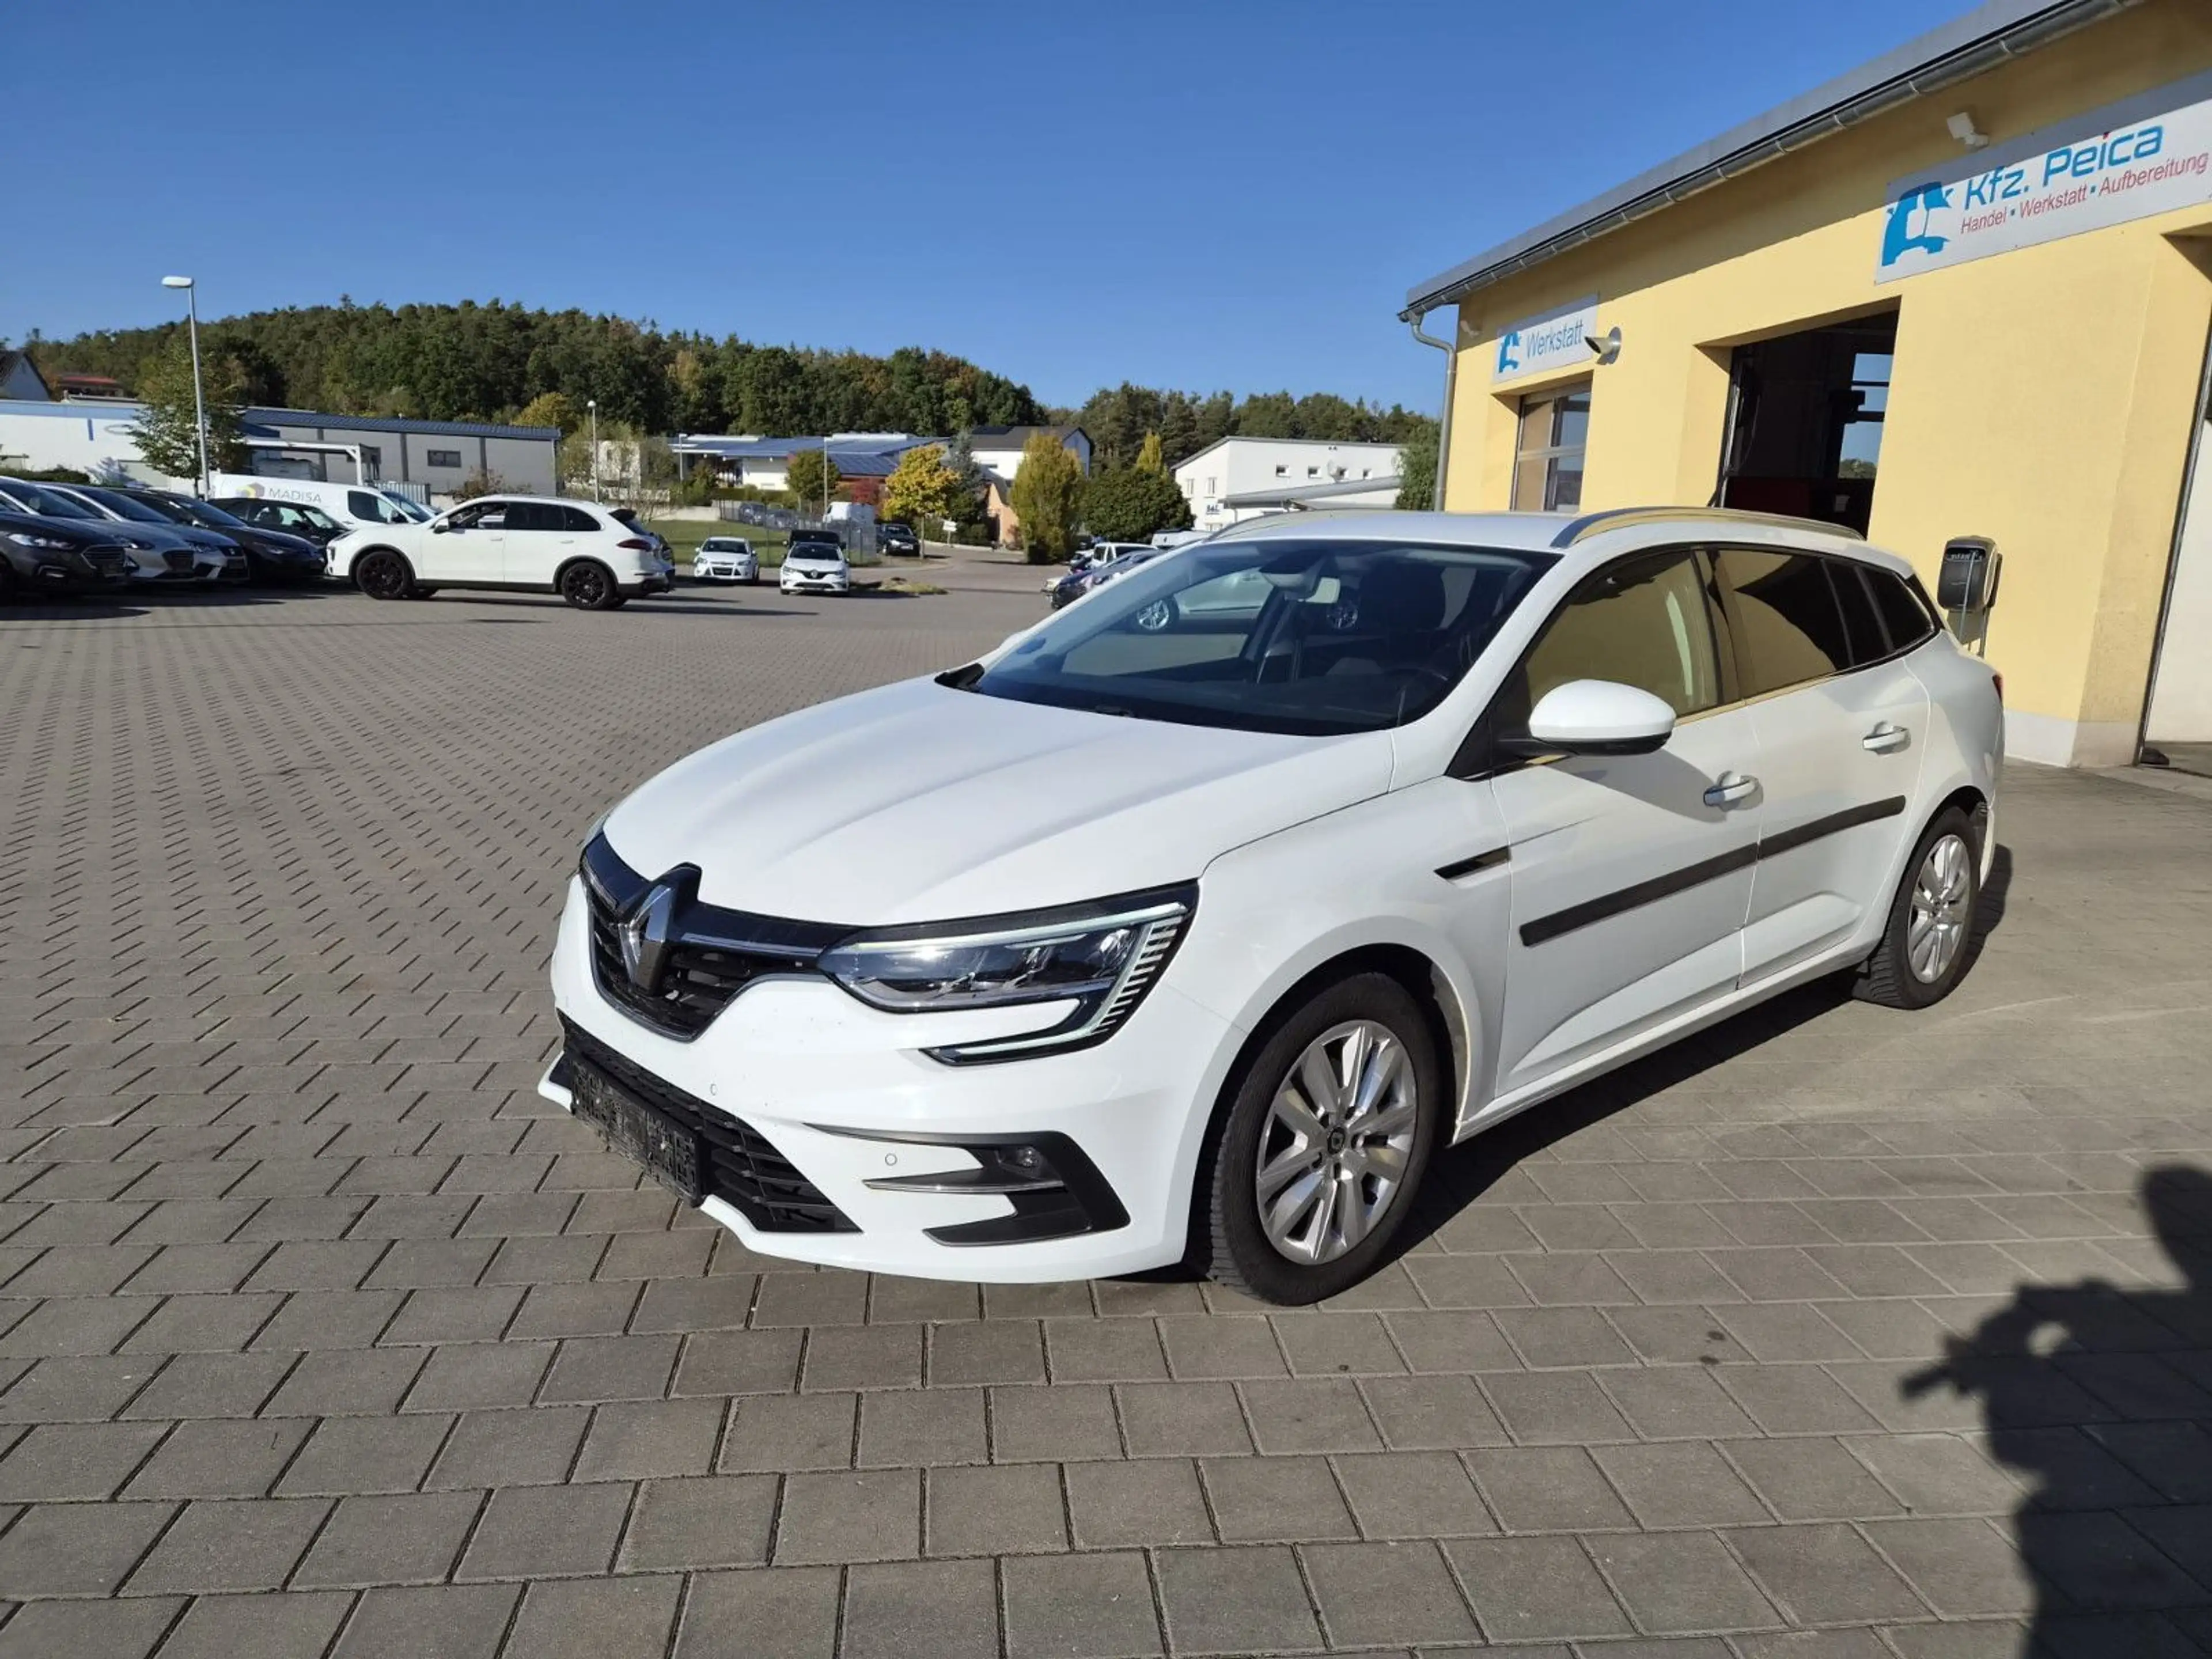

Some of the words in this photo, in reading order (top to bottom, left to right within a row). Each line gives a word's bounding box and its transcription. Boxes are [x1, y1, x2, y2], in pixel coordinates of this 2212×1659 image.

[1961, 206, 2008, 234] Handel
[2019, 183, 2088, 218] Werkstatt
[2099, 152, 2209, 196] Aufbereitung
[1965, 166, 2029, 211] Kfz.
[2043, 125, 2163, 187] Peica
[1527, 319, 1583, 359] Werkstatt
[268, 487, 322, 503] MADISA
